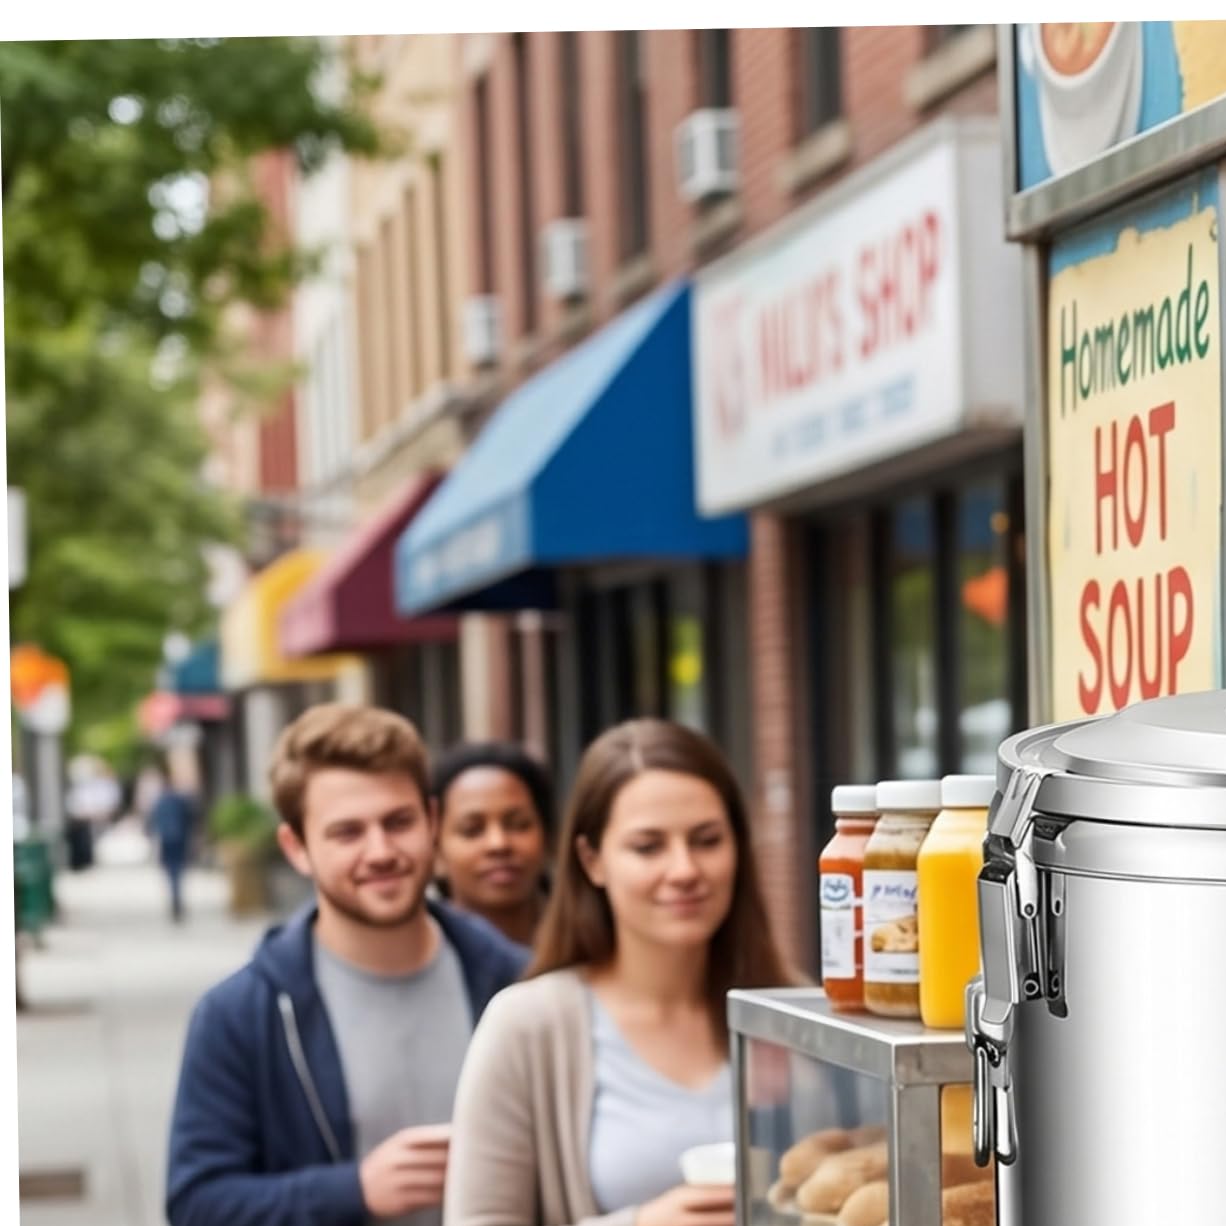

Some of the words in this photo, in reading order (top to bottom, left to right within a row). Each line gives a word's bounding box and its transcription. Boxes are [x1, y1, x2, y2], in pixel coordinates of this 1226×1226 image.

[857, 212, 939, 362] SHOP
[1060, 241, 1210, 420] Homemade
[1094, 401, 1176, 556] HOT
[1078, 565, 1195, 716] SOUP
